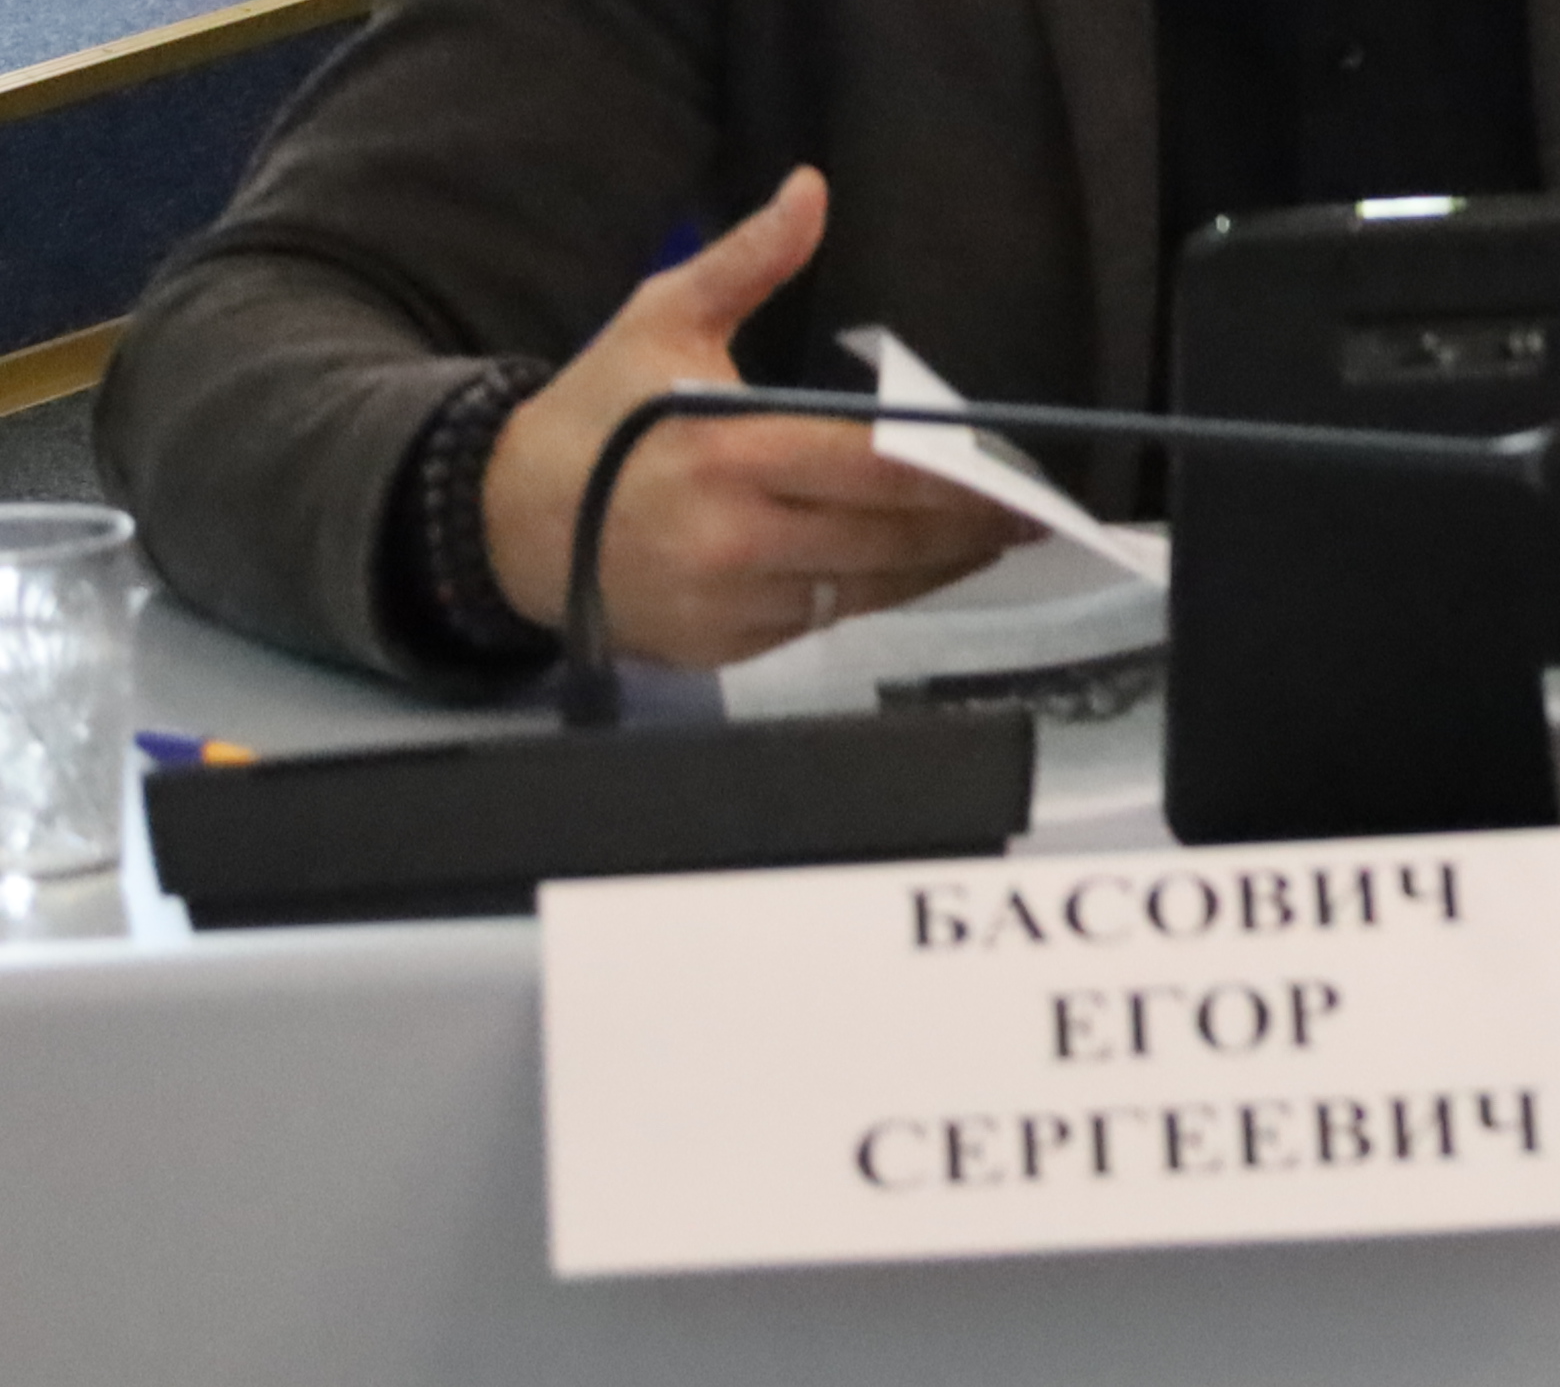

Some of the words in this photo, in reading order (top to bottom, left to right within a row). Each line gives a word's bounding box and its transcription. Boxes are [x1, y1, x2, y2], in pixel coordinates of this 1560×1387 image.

[910, 861, 1461, 949] БАСОВИЧ
[1050, 979, 1341, 1062] ЕГОР
[852, 1088, 1541, 1187] СЕРГЕЕВИЧ
